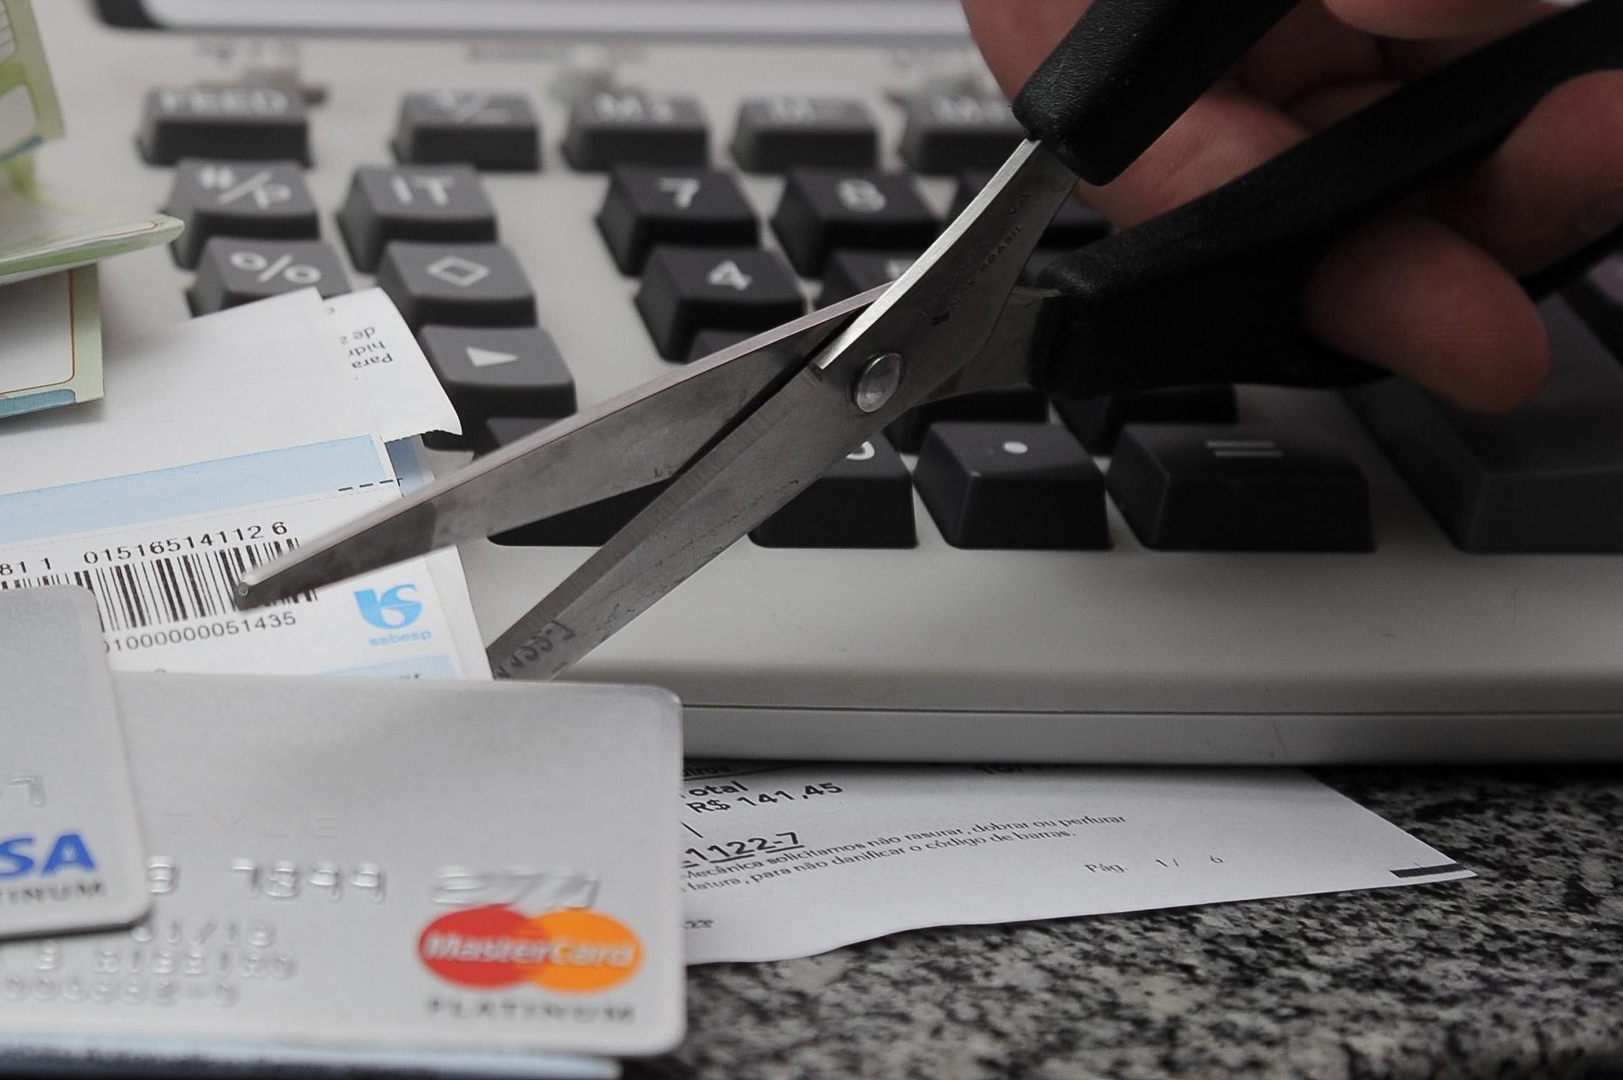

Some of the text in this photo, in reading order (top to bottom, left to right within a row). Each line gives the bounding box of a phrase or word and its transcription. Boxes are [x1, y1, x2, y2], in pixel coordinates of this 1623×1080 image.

[656, 176, 701, 209] 7
[837, 177, 888, 213] 8
[229, 250, 324, 285] %
[707, 259, 755, 293] 4
[350, 350, 394, 370] Para
[83, 524, 263, 566] 01516514112
[271, 520, 289, 536] 6
[681, 781, 749, 798] otal
[686, 781, 843, 814] R$ 141,45
[766, 814, 1128, 866] solicitamos não dobrar perfurar
[751, 834, 987, 885] para não danificar código
[422, 927, 637, 969] MasterCard
[426, 997, 636, 1022] PLATINUM
